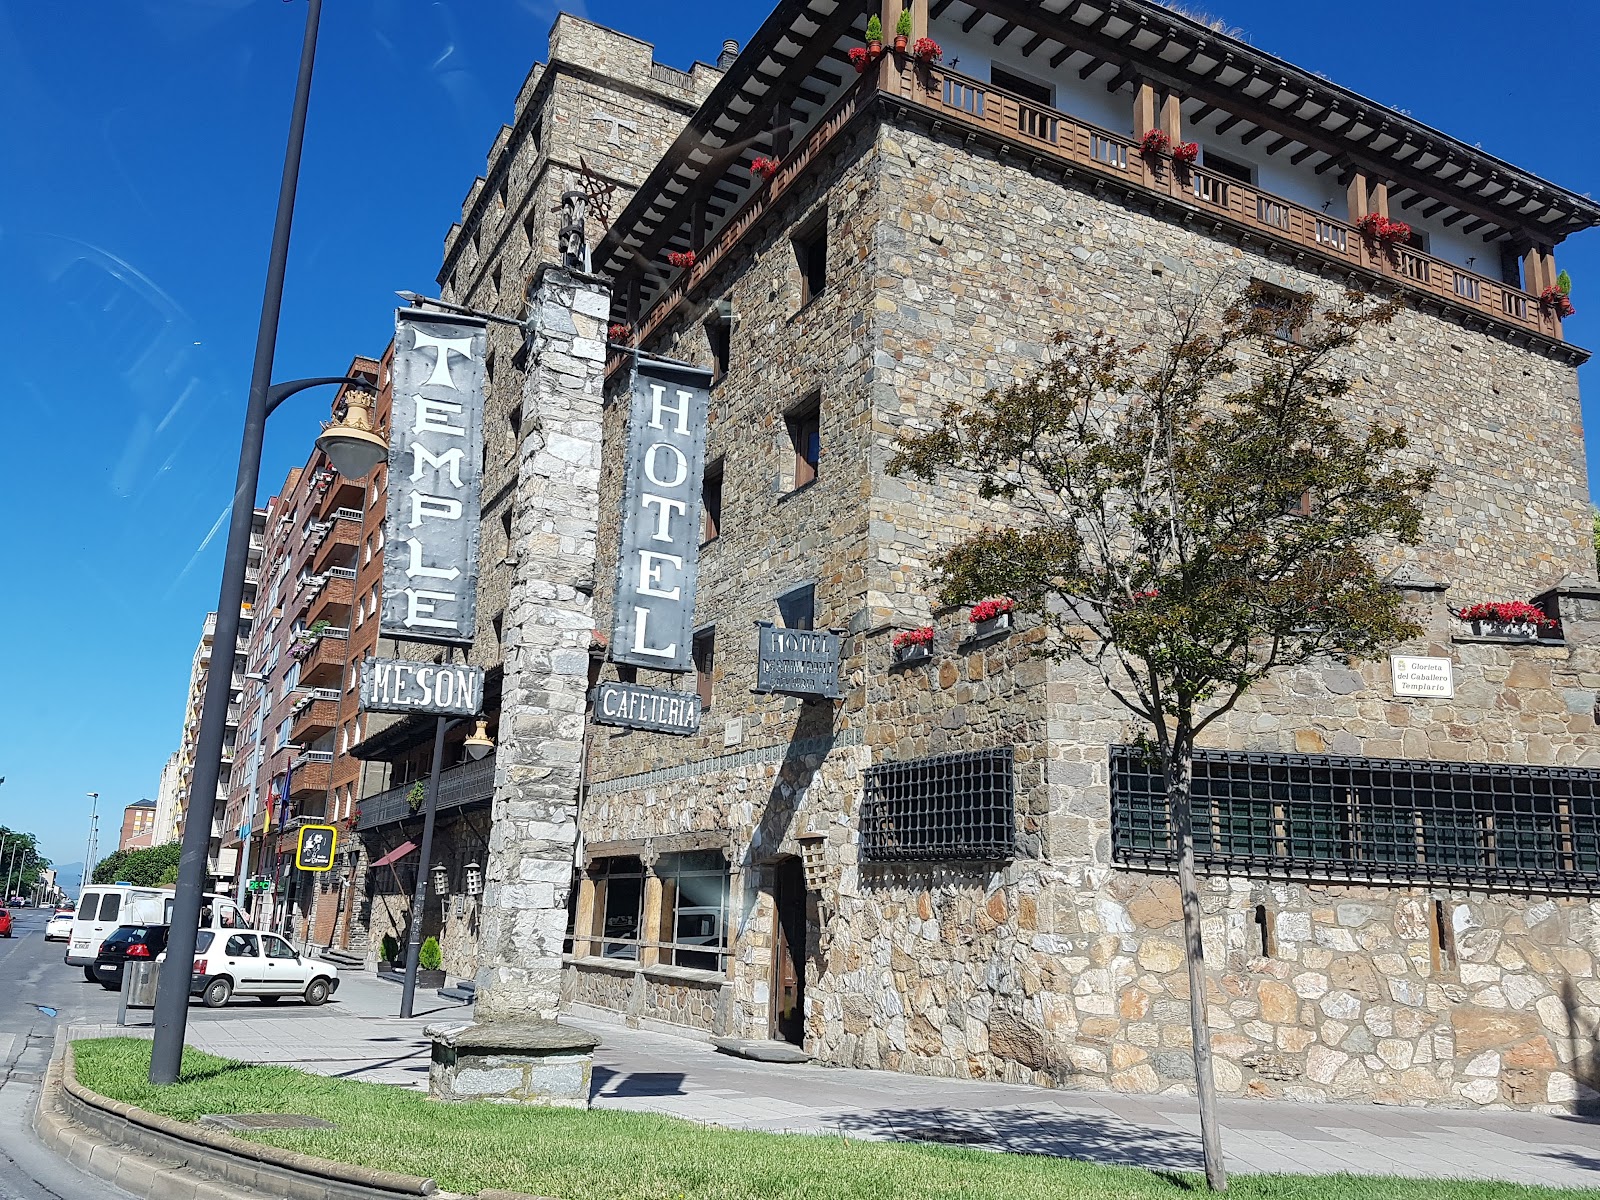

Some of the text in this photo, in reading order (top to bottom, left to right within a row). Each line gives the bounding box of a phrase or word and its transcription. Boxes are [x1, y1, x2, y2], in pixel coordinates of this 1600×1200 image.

[403, 330, 472, 630] TEMPLE
[630, 384, 692, 659] HOTEL
[771, 632, 830, 653] HOTEL
[1397, 672, 1448, 682] del Caballero
[1411, 662, 1442, 671] Glorieta
[370, 663, 475, 709] MESON
[1402, 682, 1445, 691] Templario
[603, 689, 695, 728] CAFETERIA
